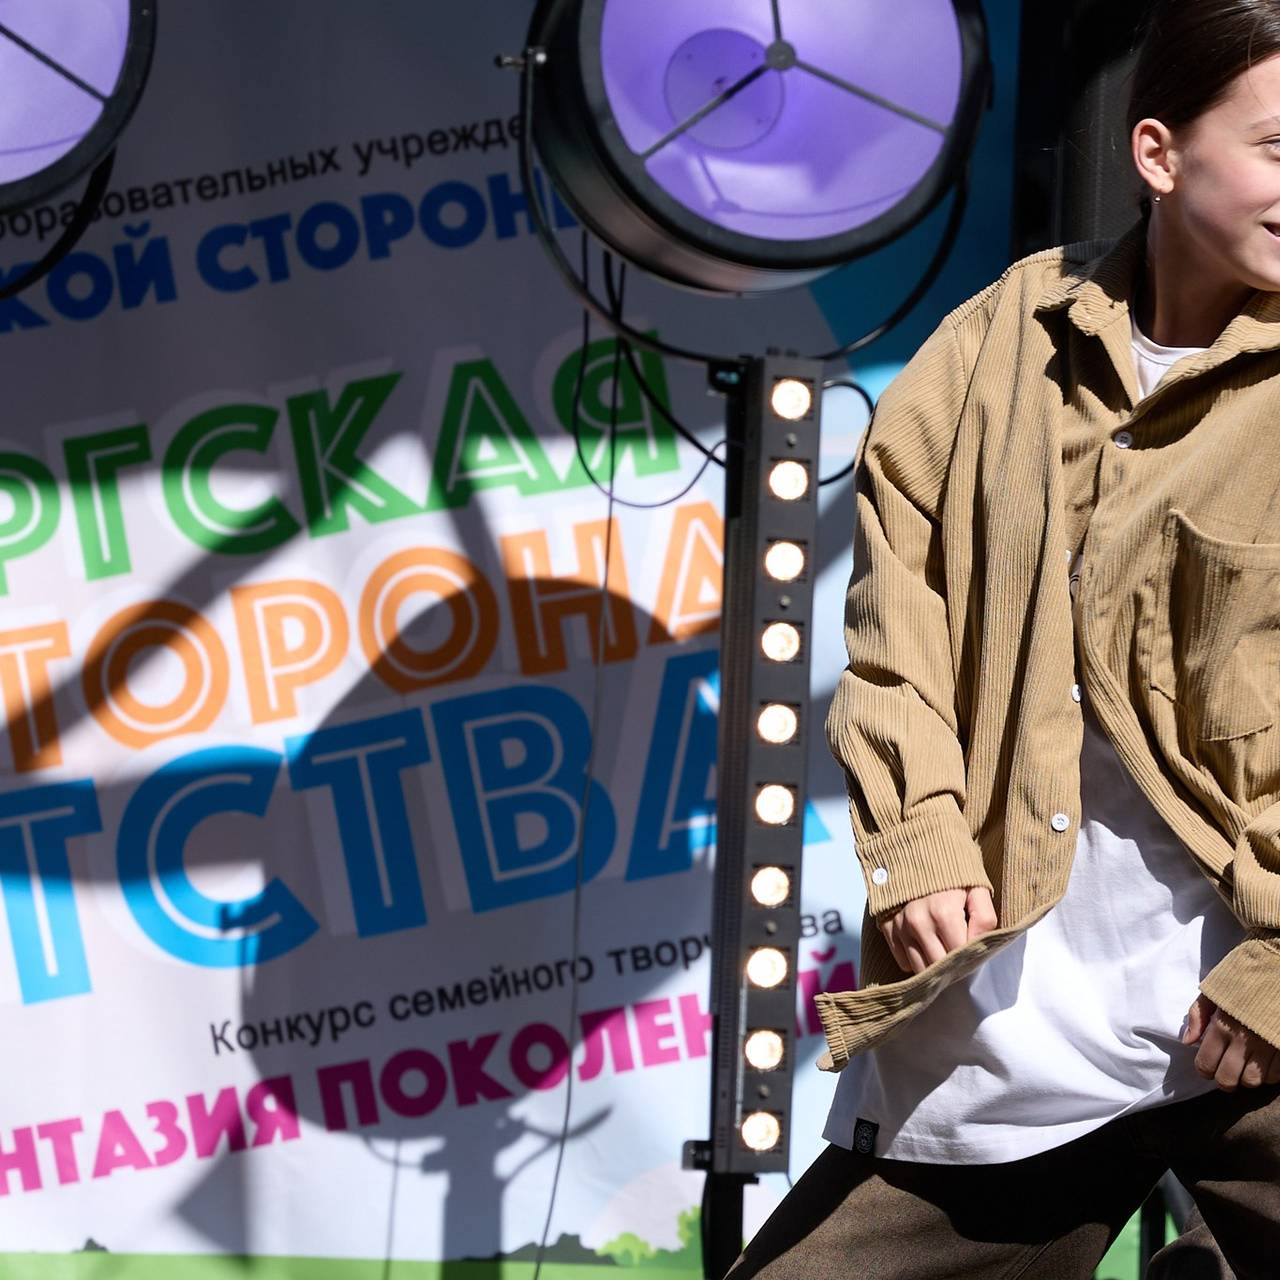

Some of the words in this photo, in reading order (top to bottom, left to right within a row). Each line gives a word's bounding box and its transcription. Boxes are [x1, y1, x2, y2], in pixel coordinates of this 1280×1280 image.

[0, 146, 341, 241] браовательных
[210, 1001, 376, 1055] Конкурс
[388, 955, 595, 1022] семейного
[317, 945, 858, 1132] ПОКОЛЕНЙ
